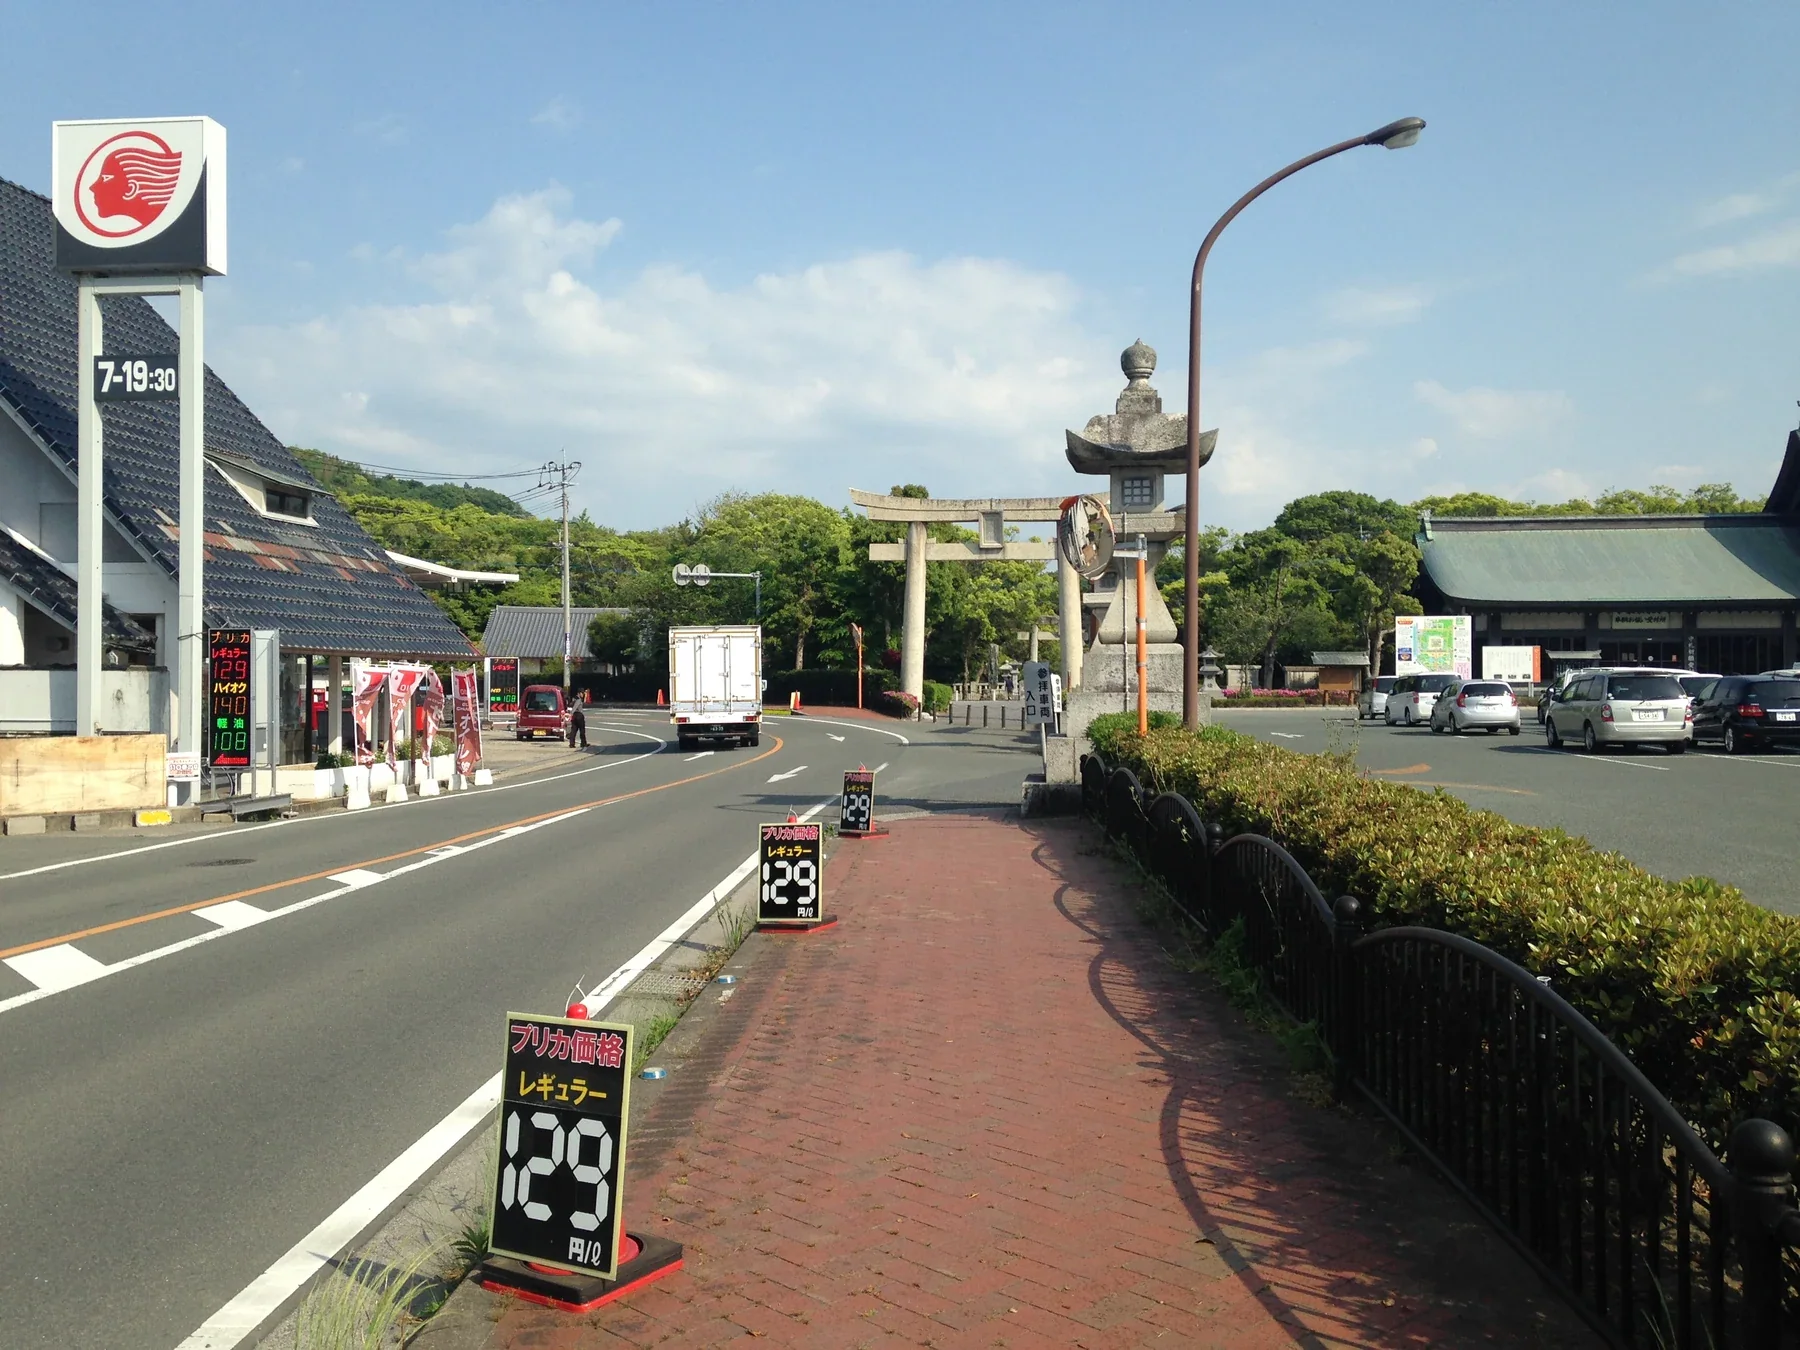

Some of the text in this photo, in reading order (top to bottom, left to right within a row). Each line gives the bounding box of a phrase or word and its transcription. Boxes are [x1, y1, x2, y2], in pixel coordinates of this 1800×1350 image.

[97, 360, 176, 394] 7-19:30
[211, 631, 250, 644] プリカ
[212, 648, 248, 659] レギュラー
[214, 661, 247, 680] 129
[214, 682, 247, 694] ハイオク
[1038, 668, 1050, 717] 参拝車両
[214, 696, 246, 715] 140
[1026, 690, 1036, 716] 入口
[214, 731, 247, 751] 108
[843, 794, 870, 822] 129
[762, 826, 819, 841] プリカ価格
[767, 845, 812, 858] レギュラー
[762, 860, 817, 905] 129
[511, 1025, 624, 1067] プリカ価格
[518, 1070, 607, 1105] レギュラー
[501, 1110, 613, 1232] 129
